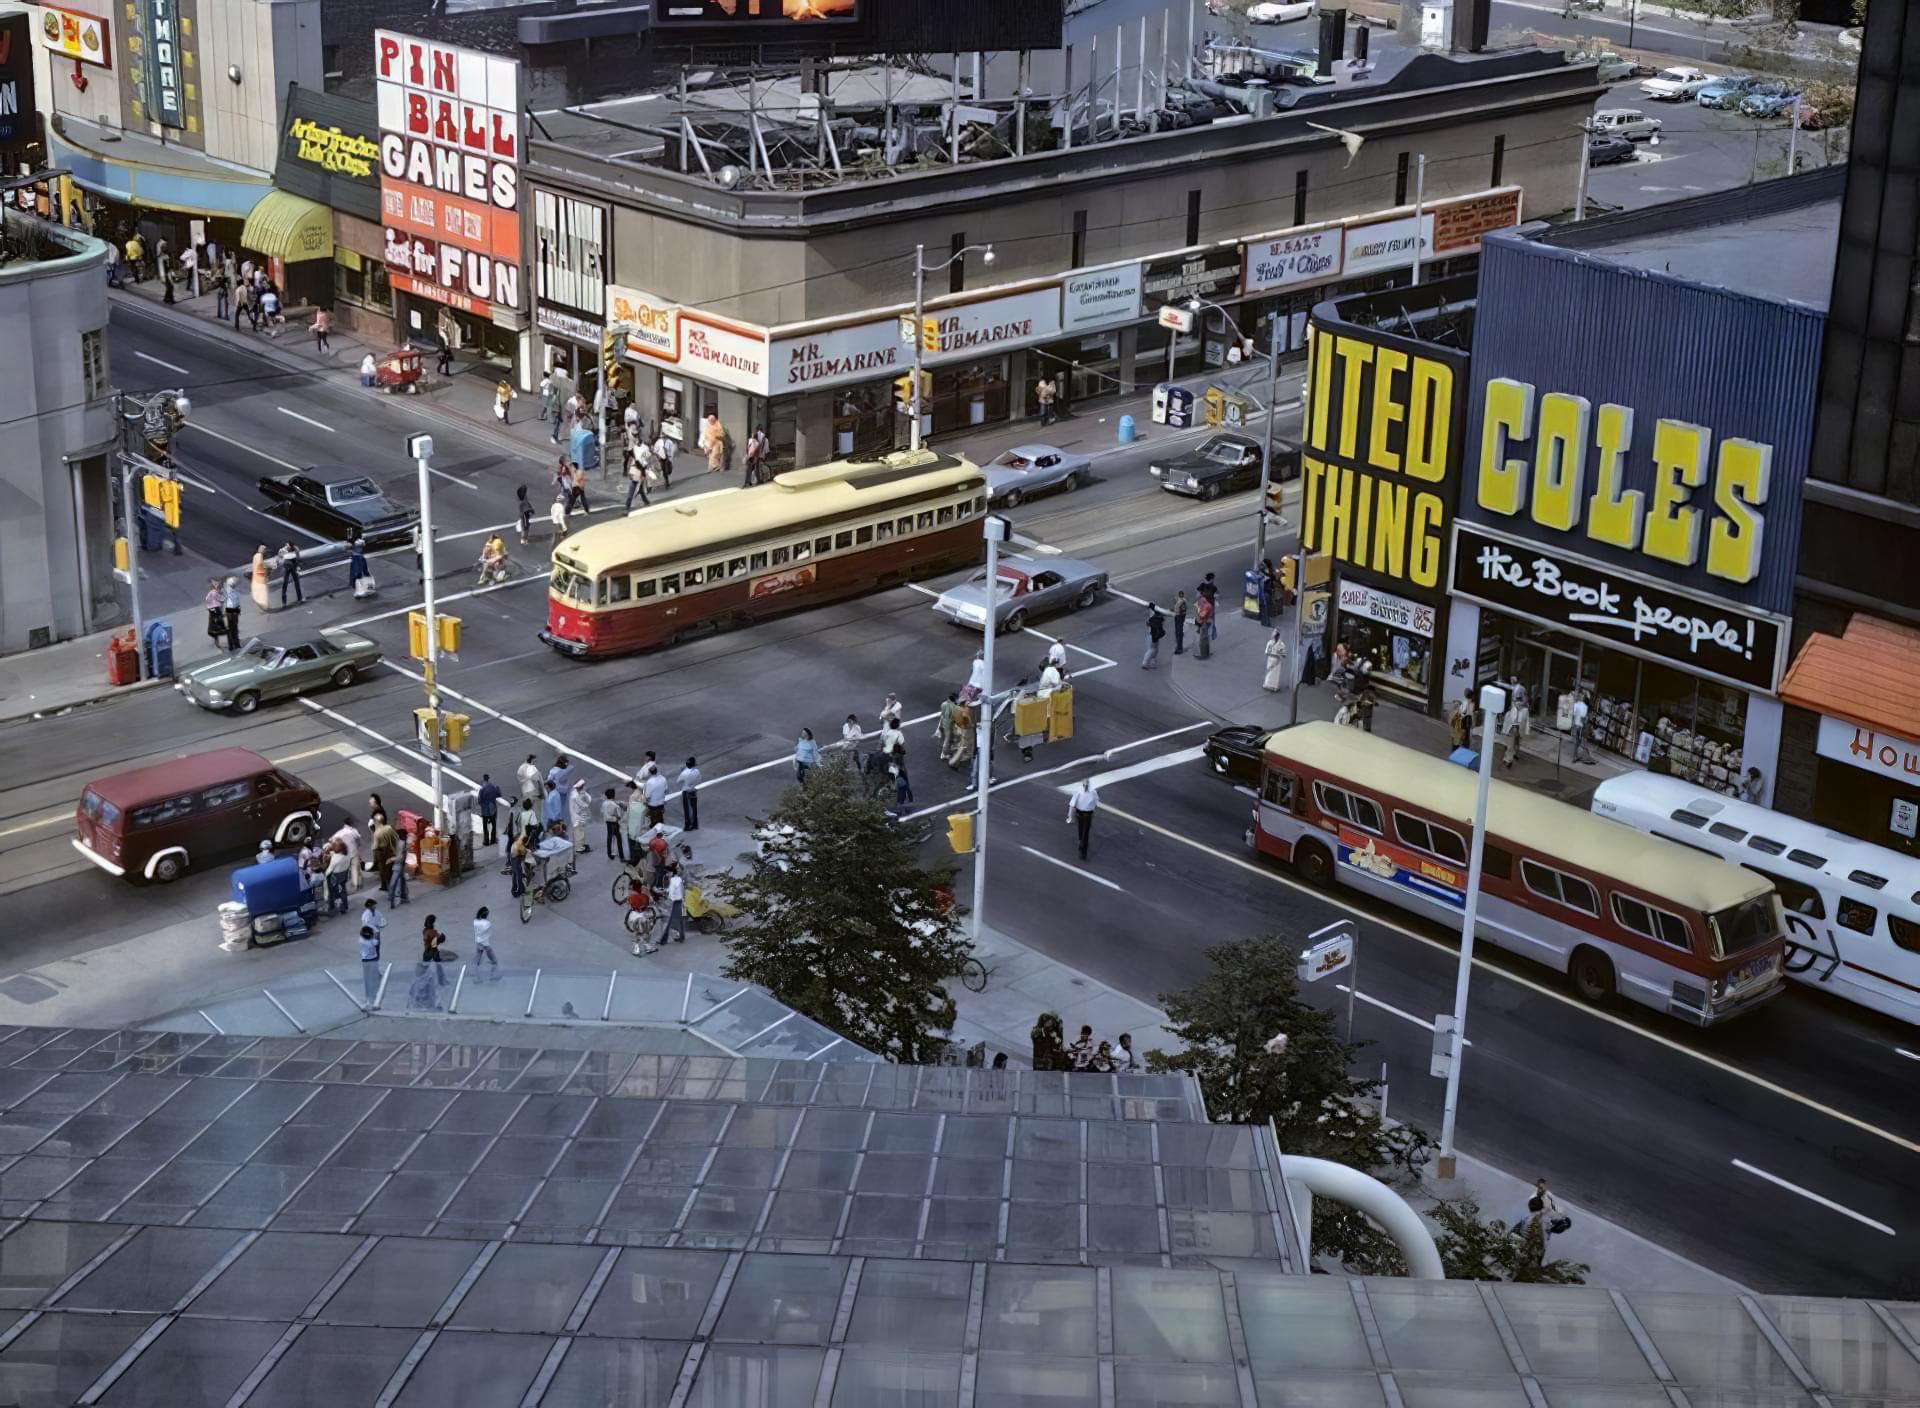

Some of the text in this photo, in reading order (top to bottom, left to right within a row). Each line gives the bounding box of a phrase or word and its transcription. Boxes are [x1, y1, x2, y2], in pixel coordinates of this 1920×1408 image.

[380, 36, 455, 93] PIN
[408, 92, 514, 158] BALL
[382, 134, 517, 209] GAMES
[440, 243, 518, 308] FUN
[788, 347, 897, 384] SUBMARINE
[937, 318, 1033, 352] UBMARINE
[1303, 325, 1453, 484] ITED
[1477, 376, 1773, 585] COLES
[1476, 545, 1757, 662] the Book people!
